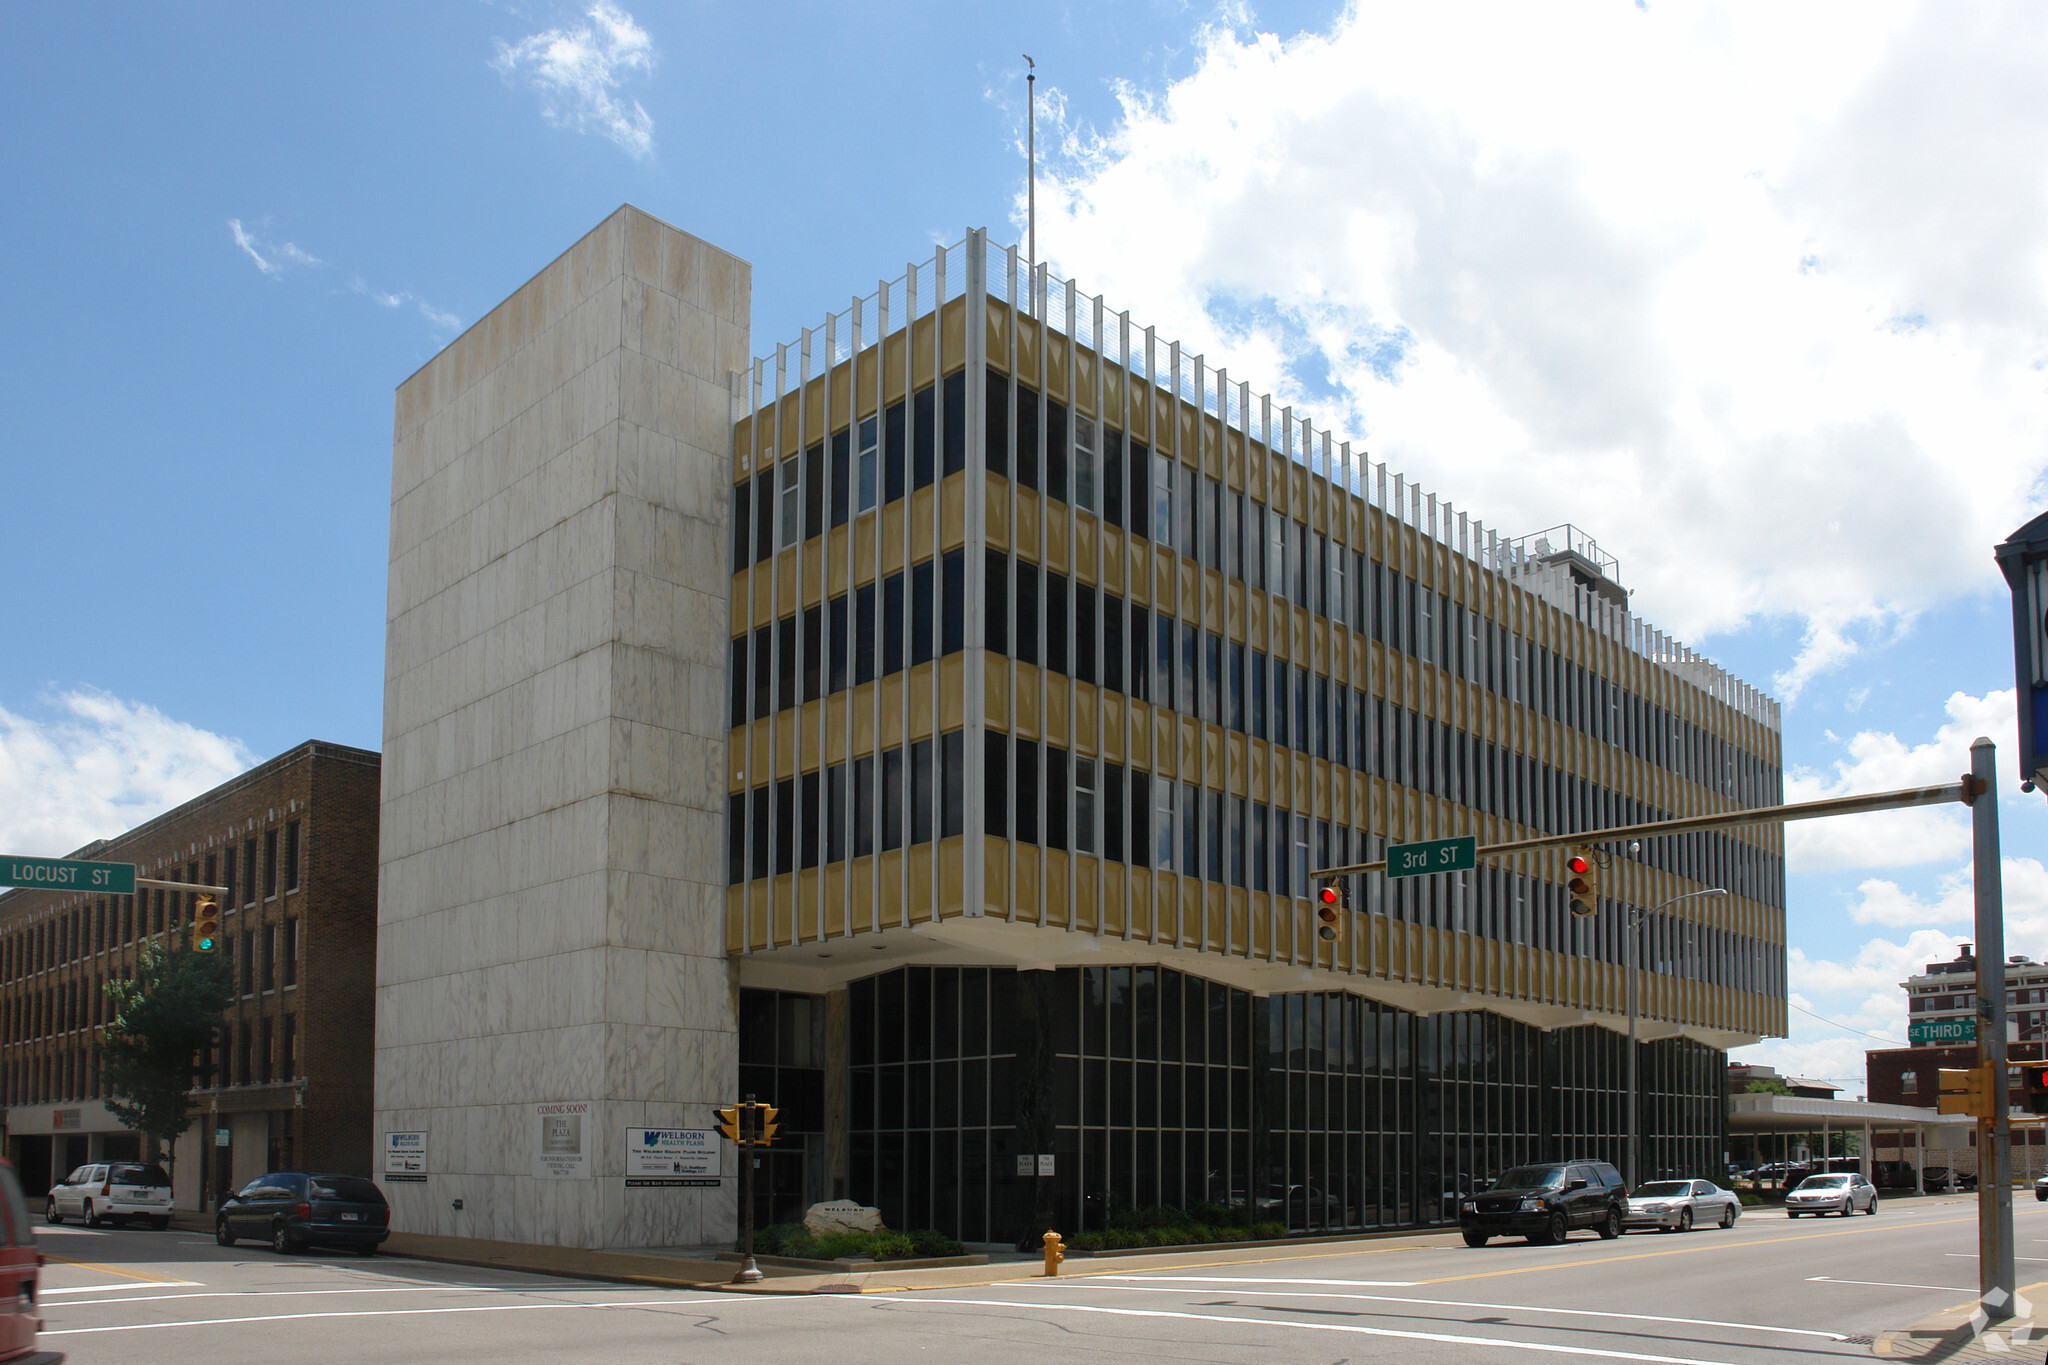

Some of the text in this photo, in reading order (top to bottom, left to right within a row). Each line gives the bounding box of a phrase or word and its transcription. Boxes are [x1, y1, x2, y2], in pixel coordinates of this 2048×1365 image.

[1403, 846, 1458, 869] 3rd ST
[12, 864, 111, 885] LOCUST ST
[1909, 1028, 1920, 1037] SE
[1921, 1024, 1962, 1038] THIRD
[537, 1103, 588, 1115] COMING SOON!
[556, 1120, 567, 1128] THE
[552, 1128, 570, 1137] PLAZA
[661, 1131, 705, 1140] WELBORN
